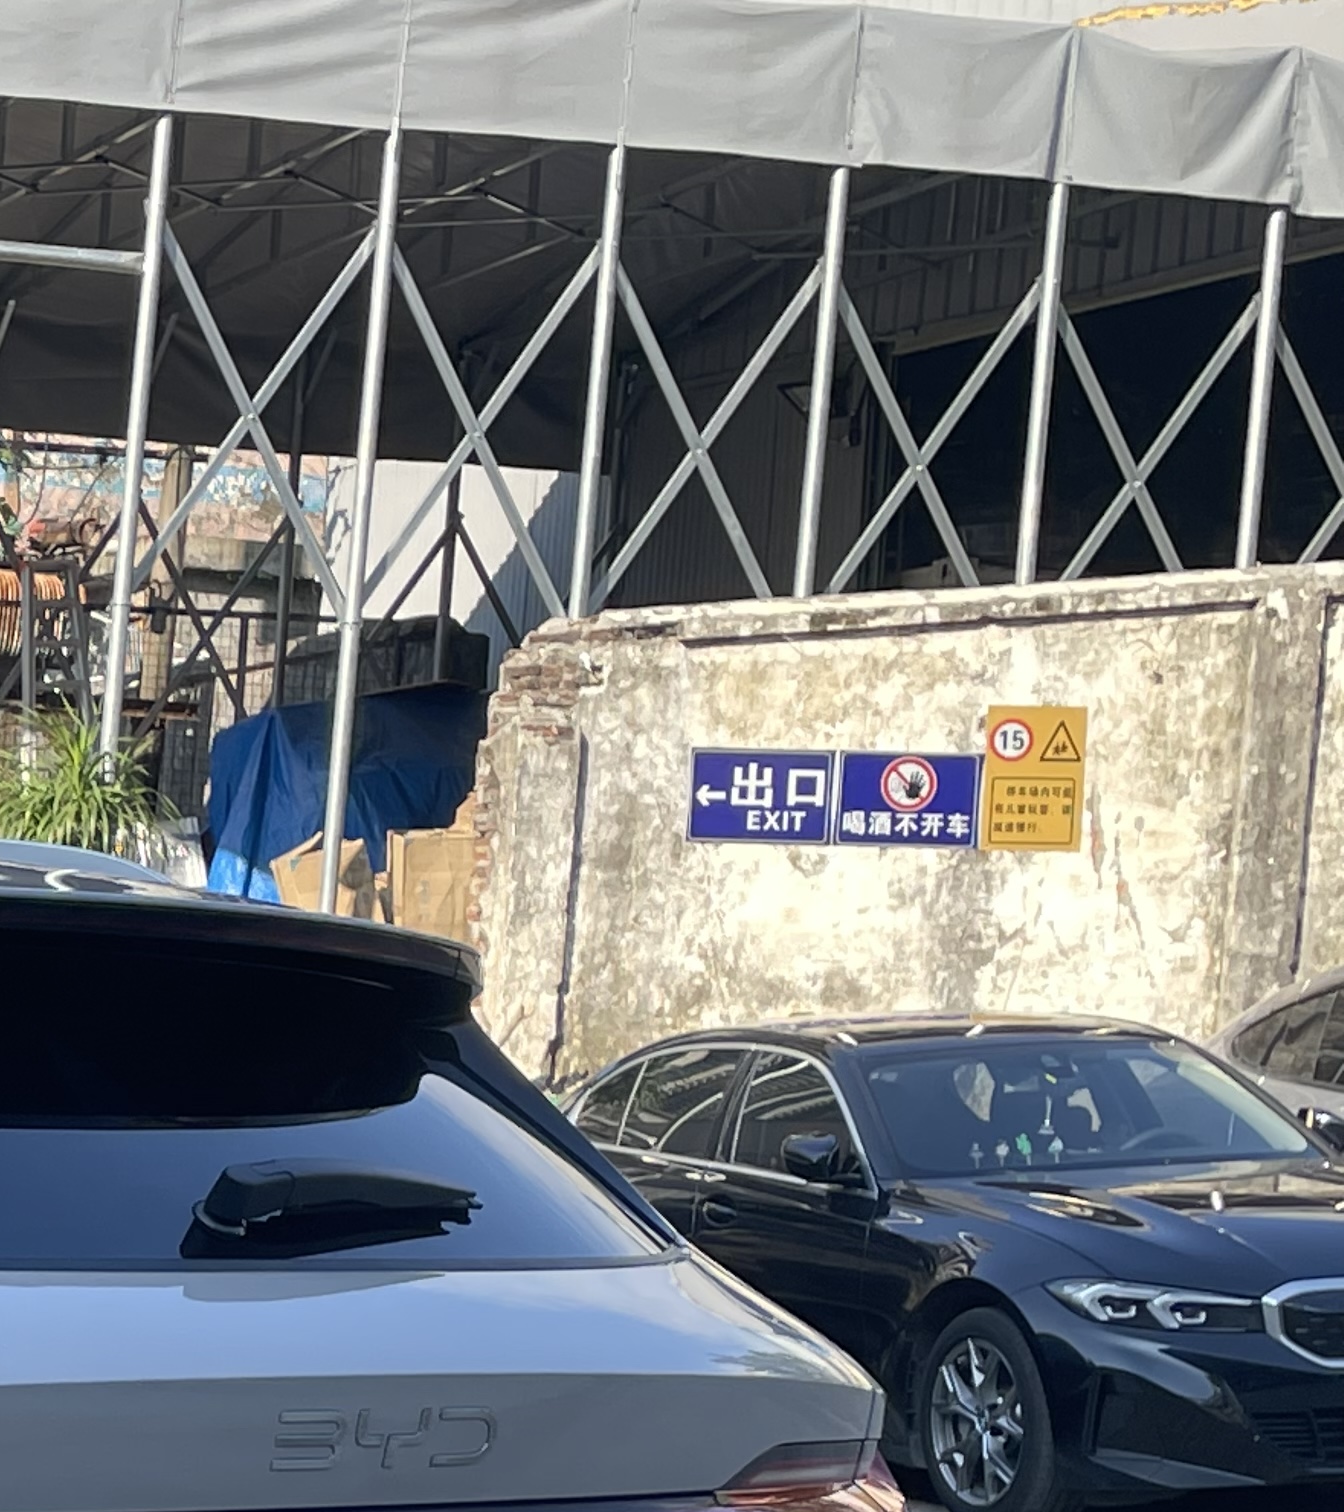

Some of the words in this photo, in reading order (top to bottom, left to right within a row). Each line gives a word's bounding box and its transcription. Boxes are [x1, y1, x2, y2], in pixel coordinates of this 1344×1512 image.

[999, 729, 1025, 751] 15
[730, 761, 826, 810] 出口
[746, 810, 808, 833] EXIT
[842, 810, 971, 839] 喝酒不开车
[269, 1405, 499, 1473] BYD
